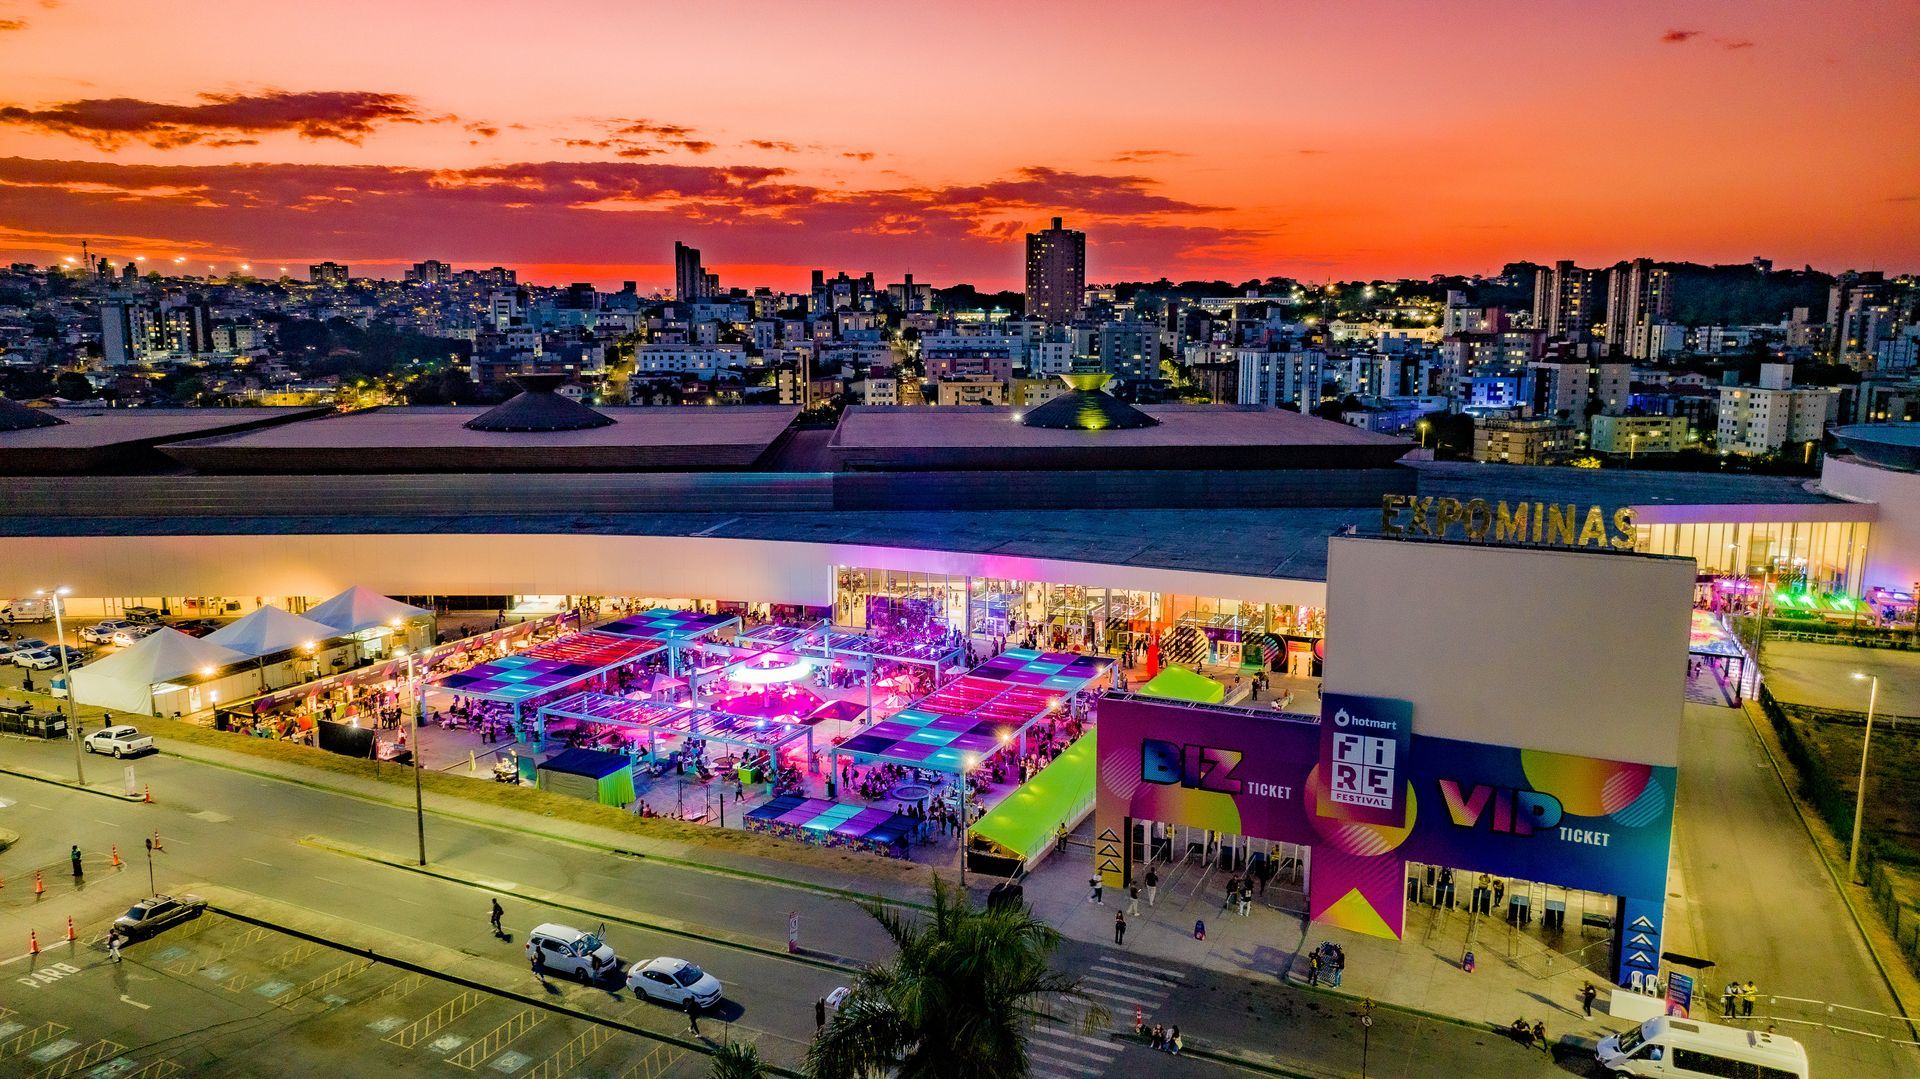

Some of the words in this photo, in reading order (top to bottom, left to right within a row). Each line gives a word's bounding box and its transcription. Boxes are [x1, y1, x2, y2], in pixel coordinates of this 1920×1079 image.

[1381, 494, 1639, 549] EXPOMINAS
[1351, 715, 1397, 730] hotmart
[1141, 738, 1243, 795] BIZ
[1247, 781, 1292, 800] TICKET
[1336, 793, 1387, 807] FESTIVAL
[1438, 779, 1563, 837] VIP
[1559, 826, 1611, 847] TICKET
